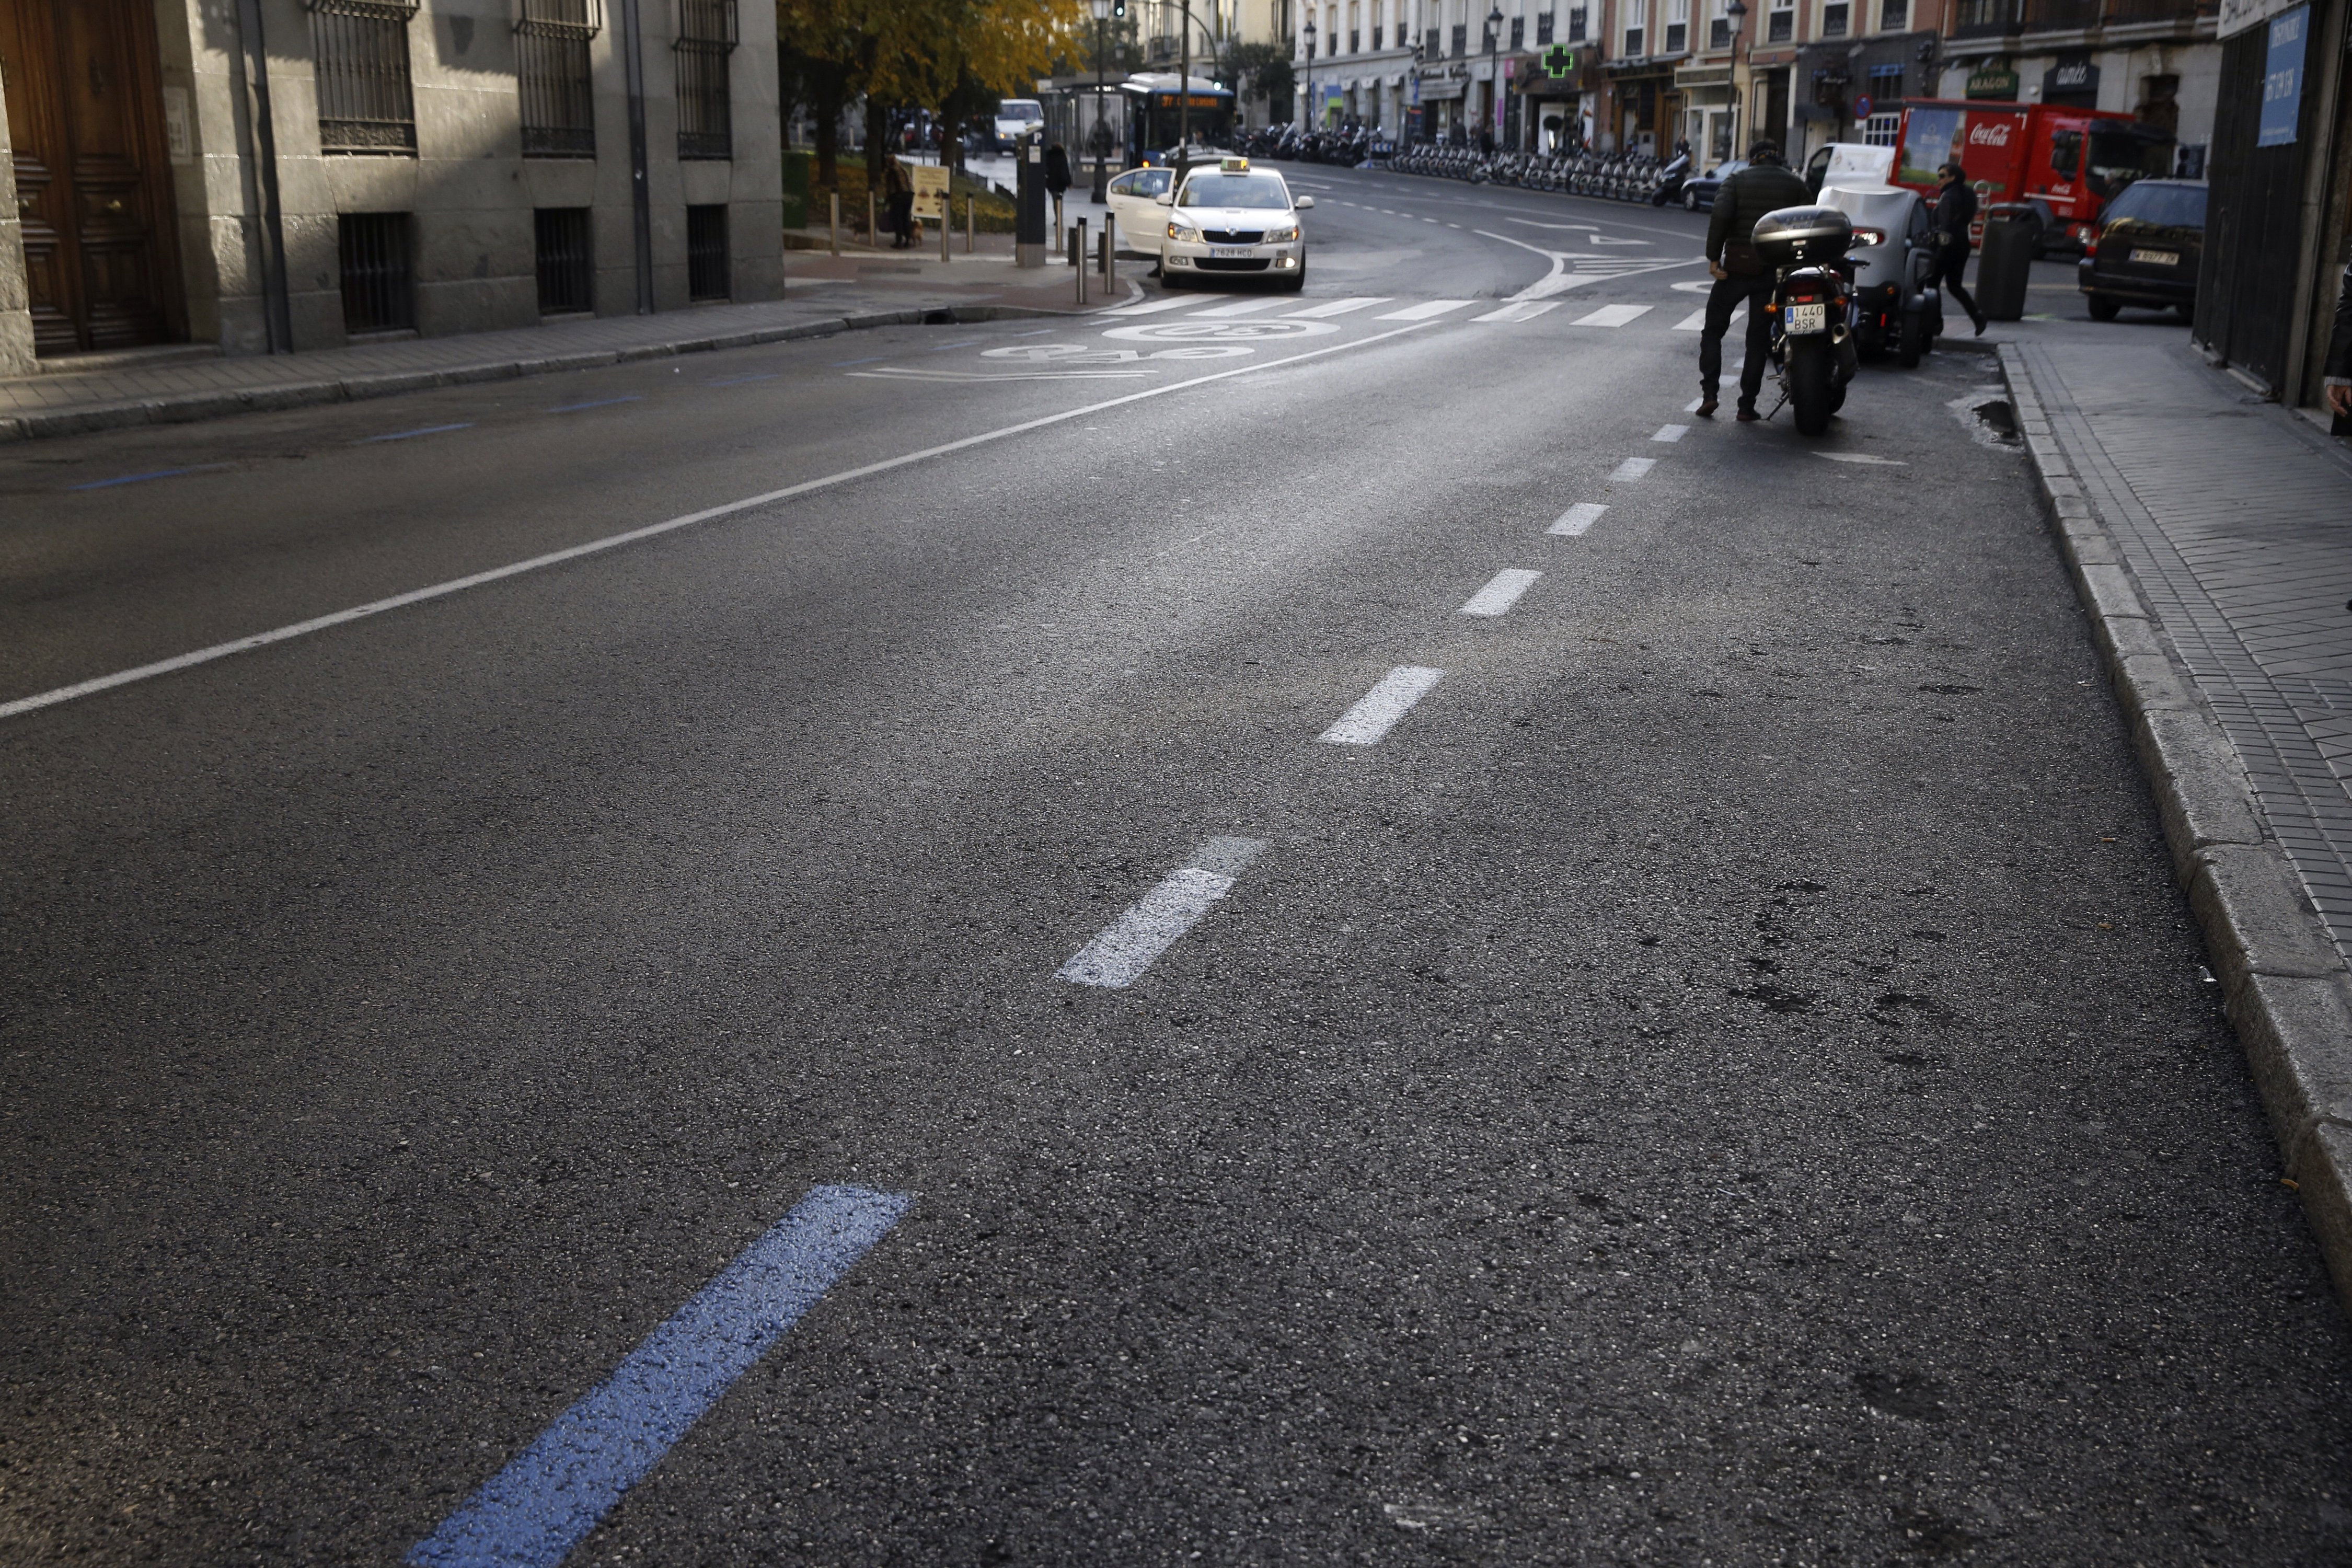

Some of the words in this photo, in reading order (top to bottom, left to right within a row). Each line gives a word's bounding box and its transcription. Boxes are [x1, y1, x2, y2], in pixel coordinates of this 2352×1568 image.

[1033, 132, 1043, 144] P
[1795, 306, 1823, 317] 1440
[1795, 318, 1815, 329] BSR
